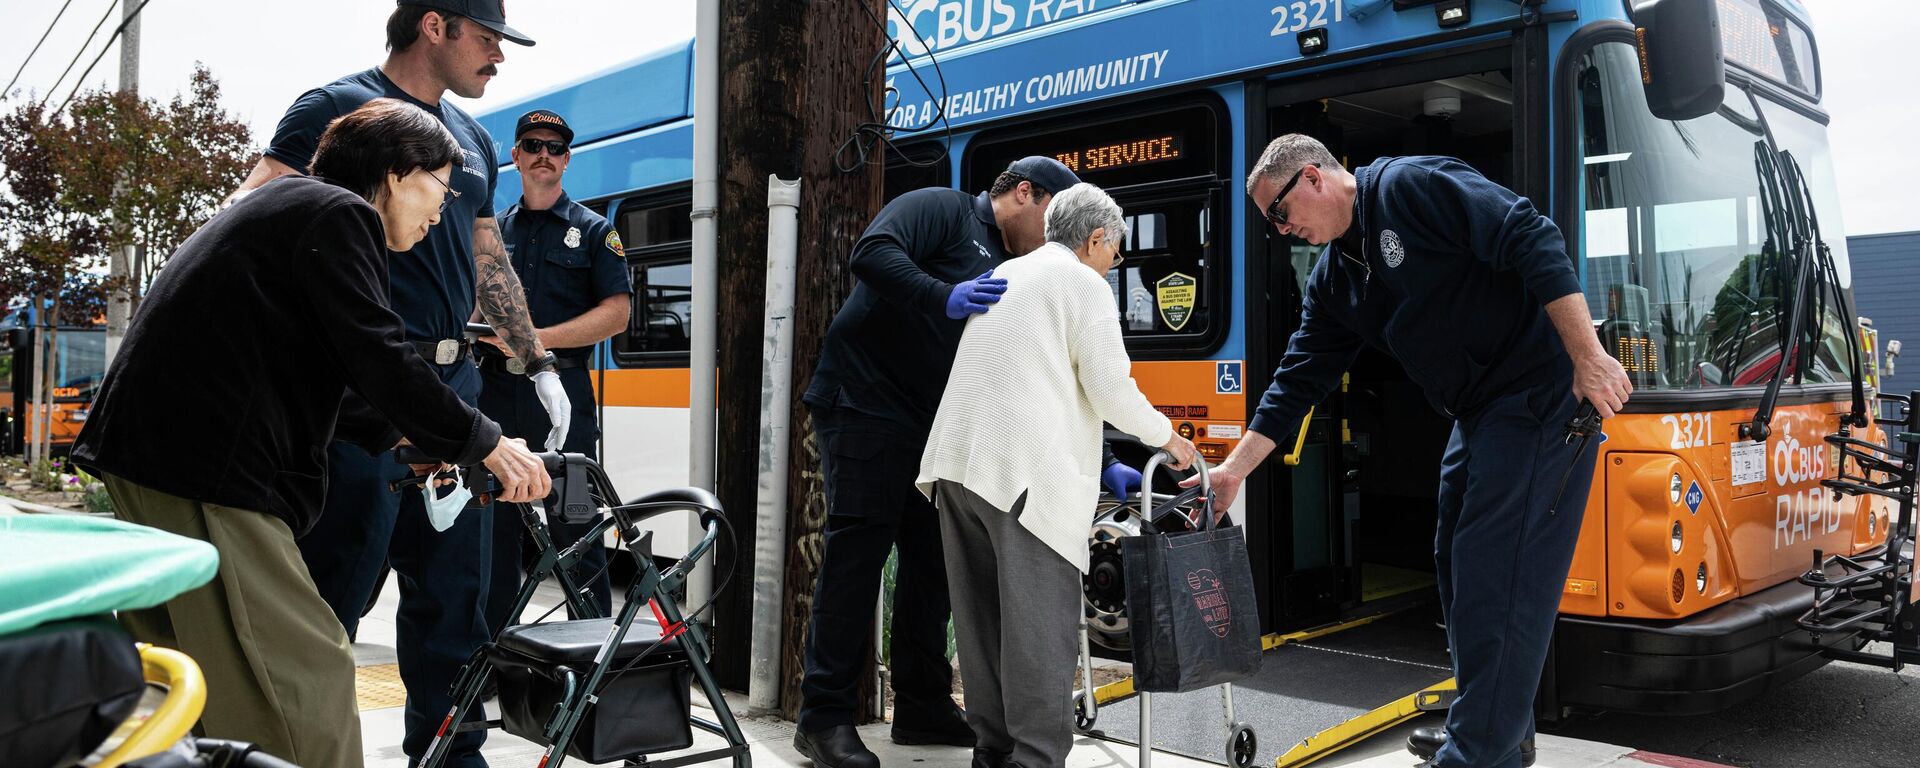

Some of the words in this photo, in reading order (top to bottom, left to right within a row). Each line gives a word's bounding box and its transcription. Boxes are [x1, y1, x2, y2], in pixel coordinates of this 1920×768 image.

[1270, 0, 1342, 36] 2321
[918, 100, 931, 125] A
[937, 81, 1022, 120] HEALTHY
[1025, 49, 1170, 103] COMMUNITY
[1056, 152, 1078, 171] IN
[1086, 137, 1178, 169] SERVICE.
[1619, 336, 1658, 372] OCTA
[1188, 407, 1207, 416] RAMP
[1661, 413, 1712, 449] 2321
[1688, 490, 1700, 505] CNG
[1775, 486, 1841, 550] RAPID
